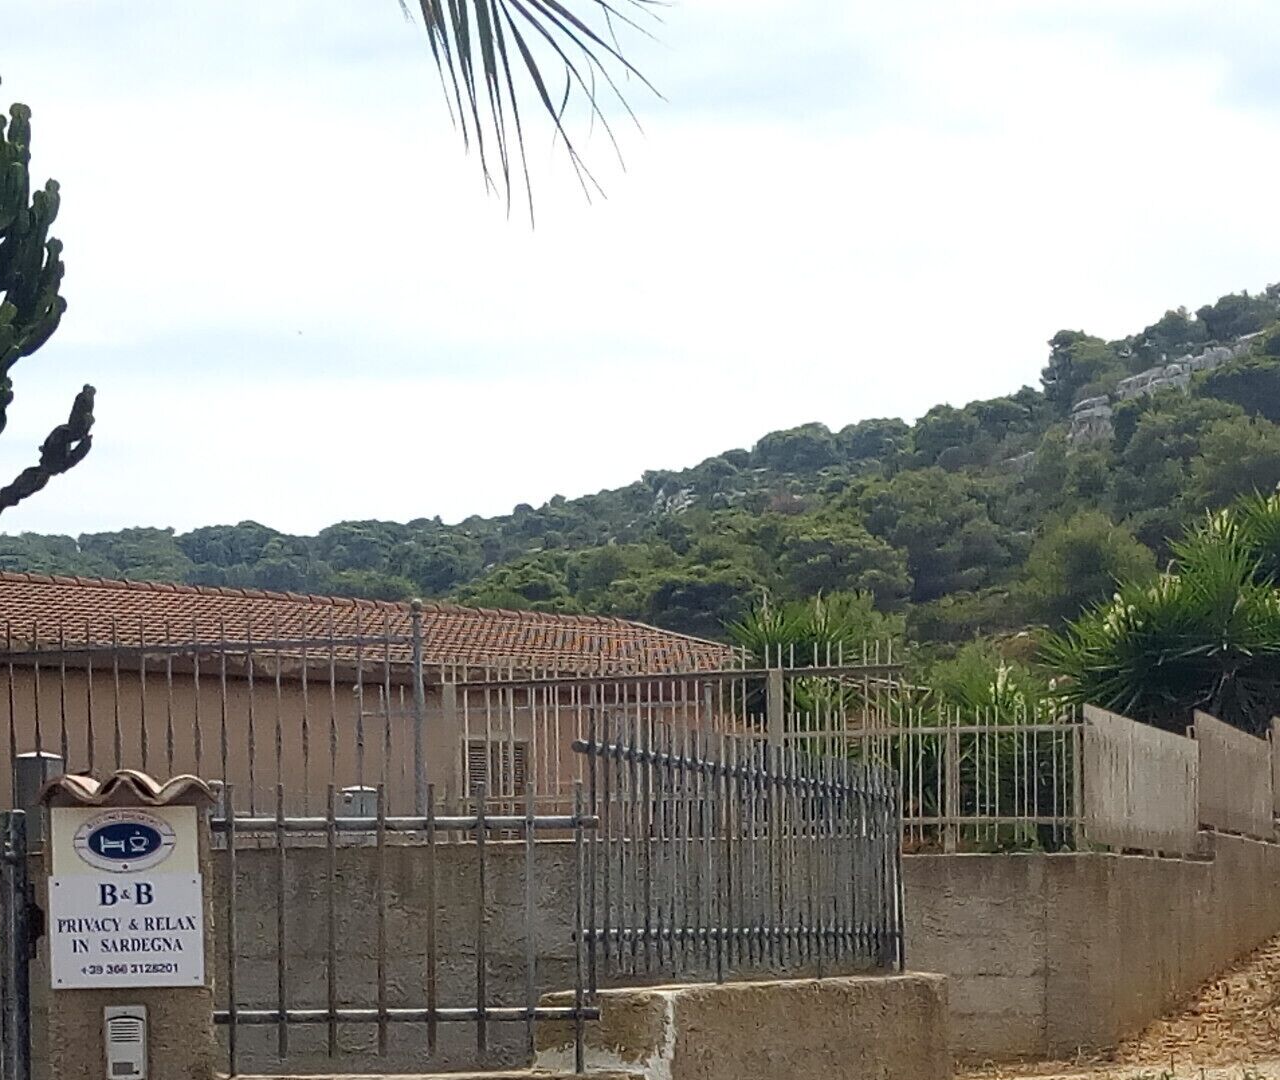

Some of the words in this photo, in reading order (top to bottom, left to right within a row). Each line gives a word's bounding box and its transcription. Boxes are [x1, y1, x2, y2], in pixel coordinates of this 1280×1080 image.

[57, 917, 121, 933] PRIVACY
[128, 919, 139, 930] &
[144, 916, 197, 930] RELAX
[72, 939, 89, 953] IN
[100, 938, 183, 952] SARDEGNA
[81, 964, 104, 975] +39
